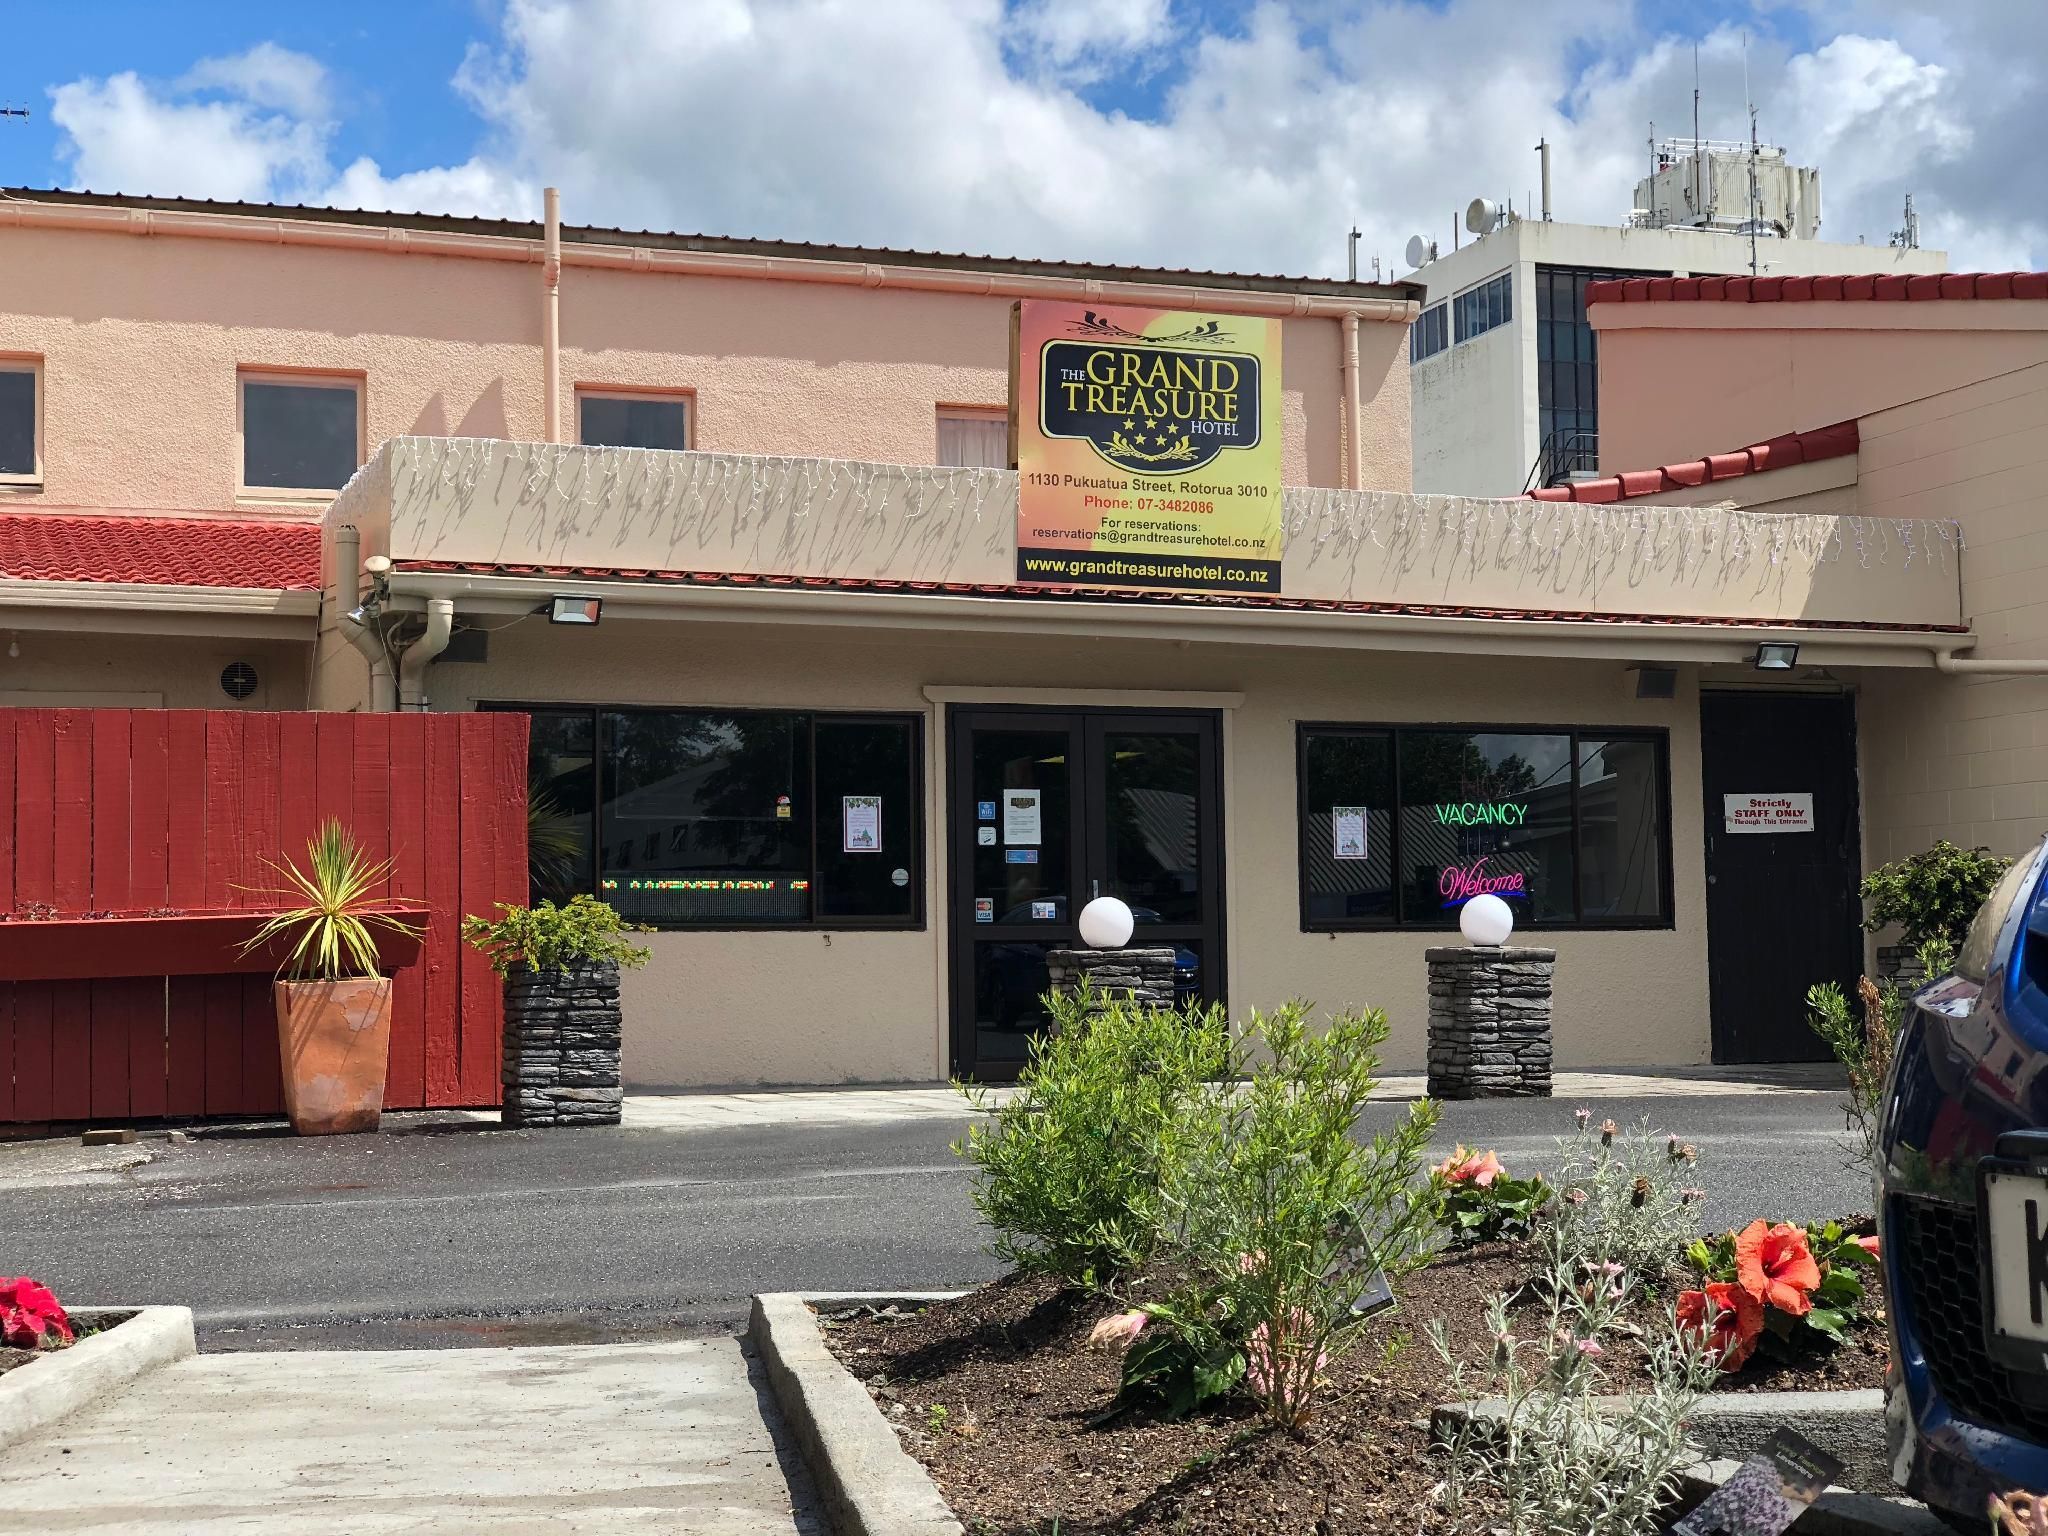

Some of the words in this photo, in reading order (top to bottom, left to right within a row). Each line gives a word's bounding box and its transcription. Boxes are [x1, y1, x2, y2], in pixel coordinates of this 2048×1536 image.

[1061, 369, 1086, 381] THE
[1086, 351, 1239, 393] GRAND
[1061, 382, 1238, 422] TREASURE
[1190, 421, 1239, 436] HOTEL
[1028, 473, 1060, 487] 1130
[1064, 475, 1128, 490] Pukuatua
[1132, 479, 1176, 494] Street,
[1180, 482, 1233, 496] Rotorua
[1237, 485, 1268, 498] 3010
[1084, 495, 1133, 510] Phone:
[1137, 498, 1214, 514] 07-3482086
[1101, 517, 1122, 529] For
[1124, 519, 1201, 532] reservations:
[1032, 527, 1266, 548] reservations@grandtreasurehotel.co.nz
[1026, 558, 1268, 583] www.grandtreasurehotel.co.nz
[1436, 803, 1528, 826] VACANCY
[1734, 809, 1770, 818] STAFF
[1775, 809, 1805, 818] ONLY
[1749, 799, 1792, 809] Strictly
[1439, 857, 1523, 901] Welcome
